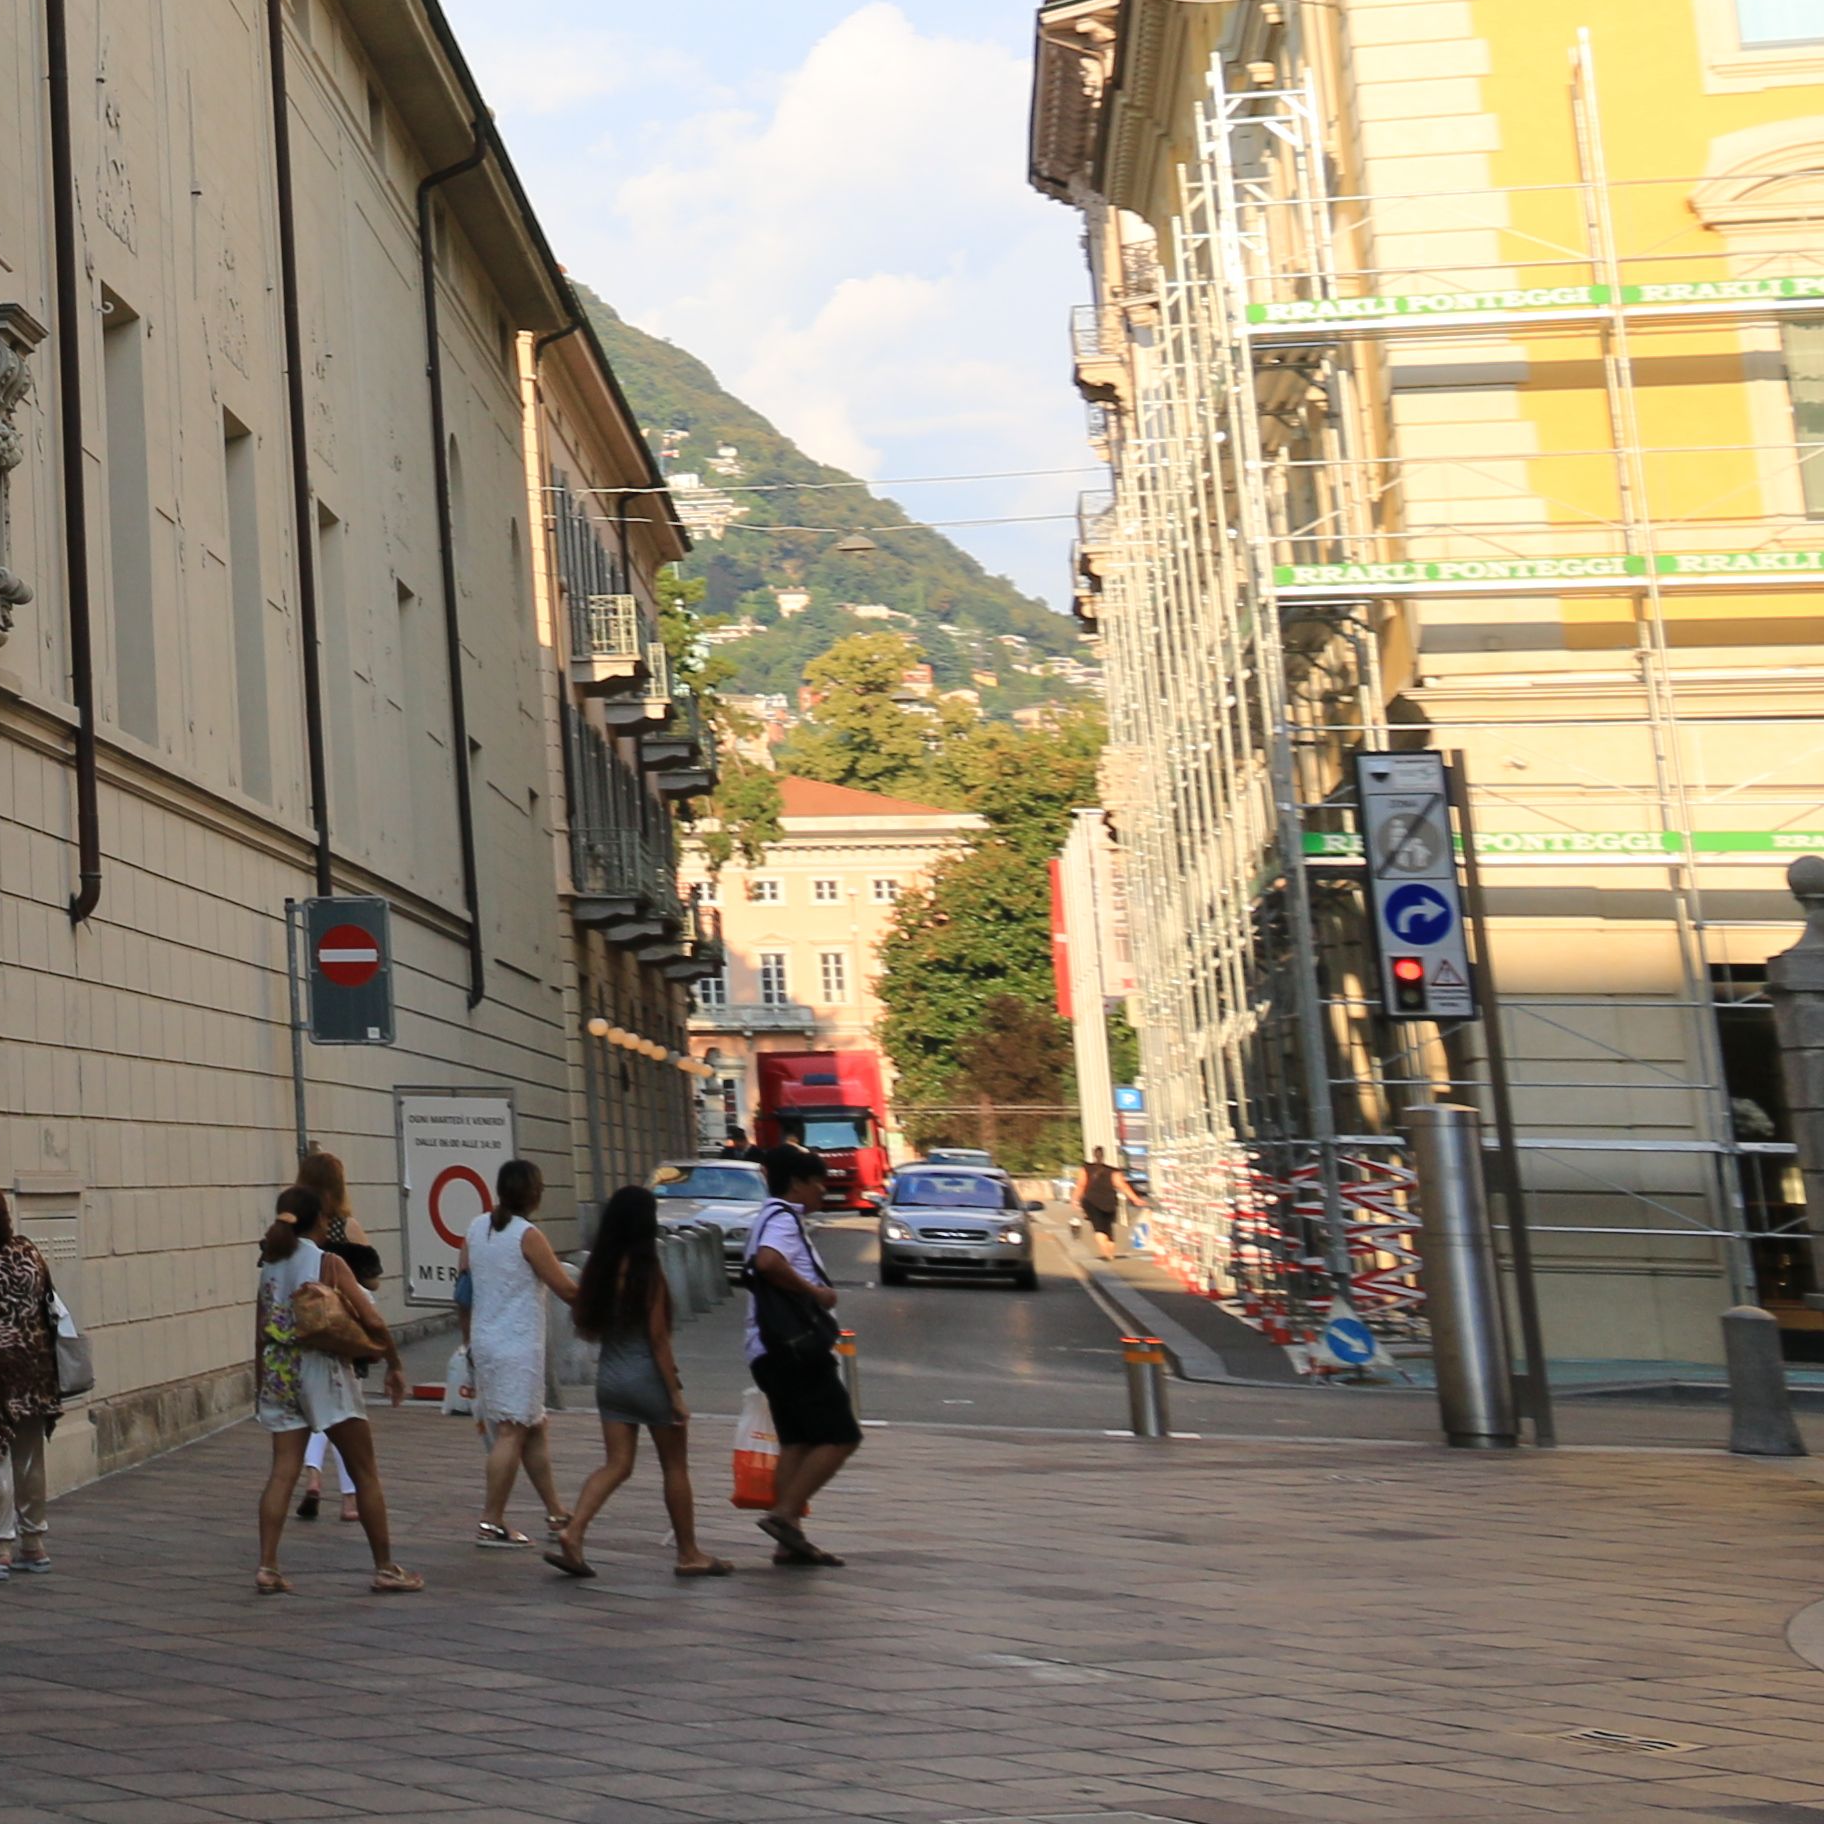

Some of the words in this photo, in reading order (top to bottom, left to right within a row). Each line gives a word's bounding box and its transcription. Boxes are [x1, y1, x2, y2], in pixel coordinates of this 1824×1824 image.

[1407, 286, 1594, 313] PONTEGGI
[1436, 556, 1627, 580] PONTEGGI
[1472, 832, 1664, 851] PONTEGGI
[415, 1137, 438, 1147] DALLE
[462, 1139, 478, 1149] ALLE
